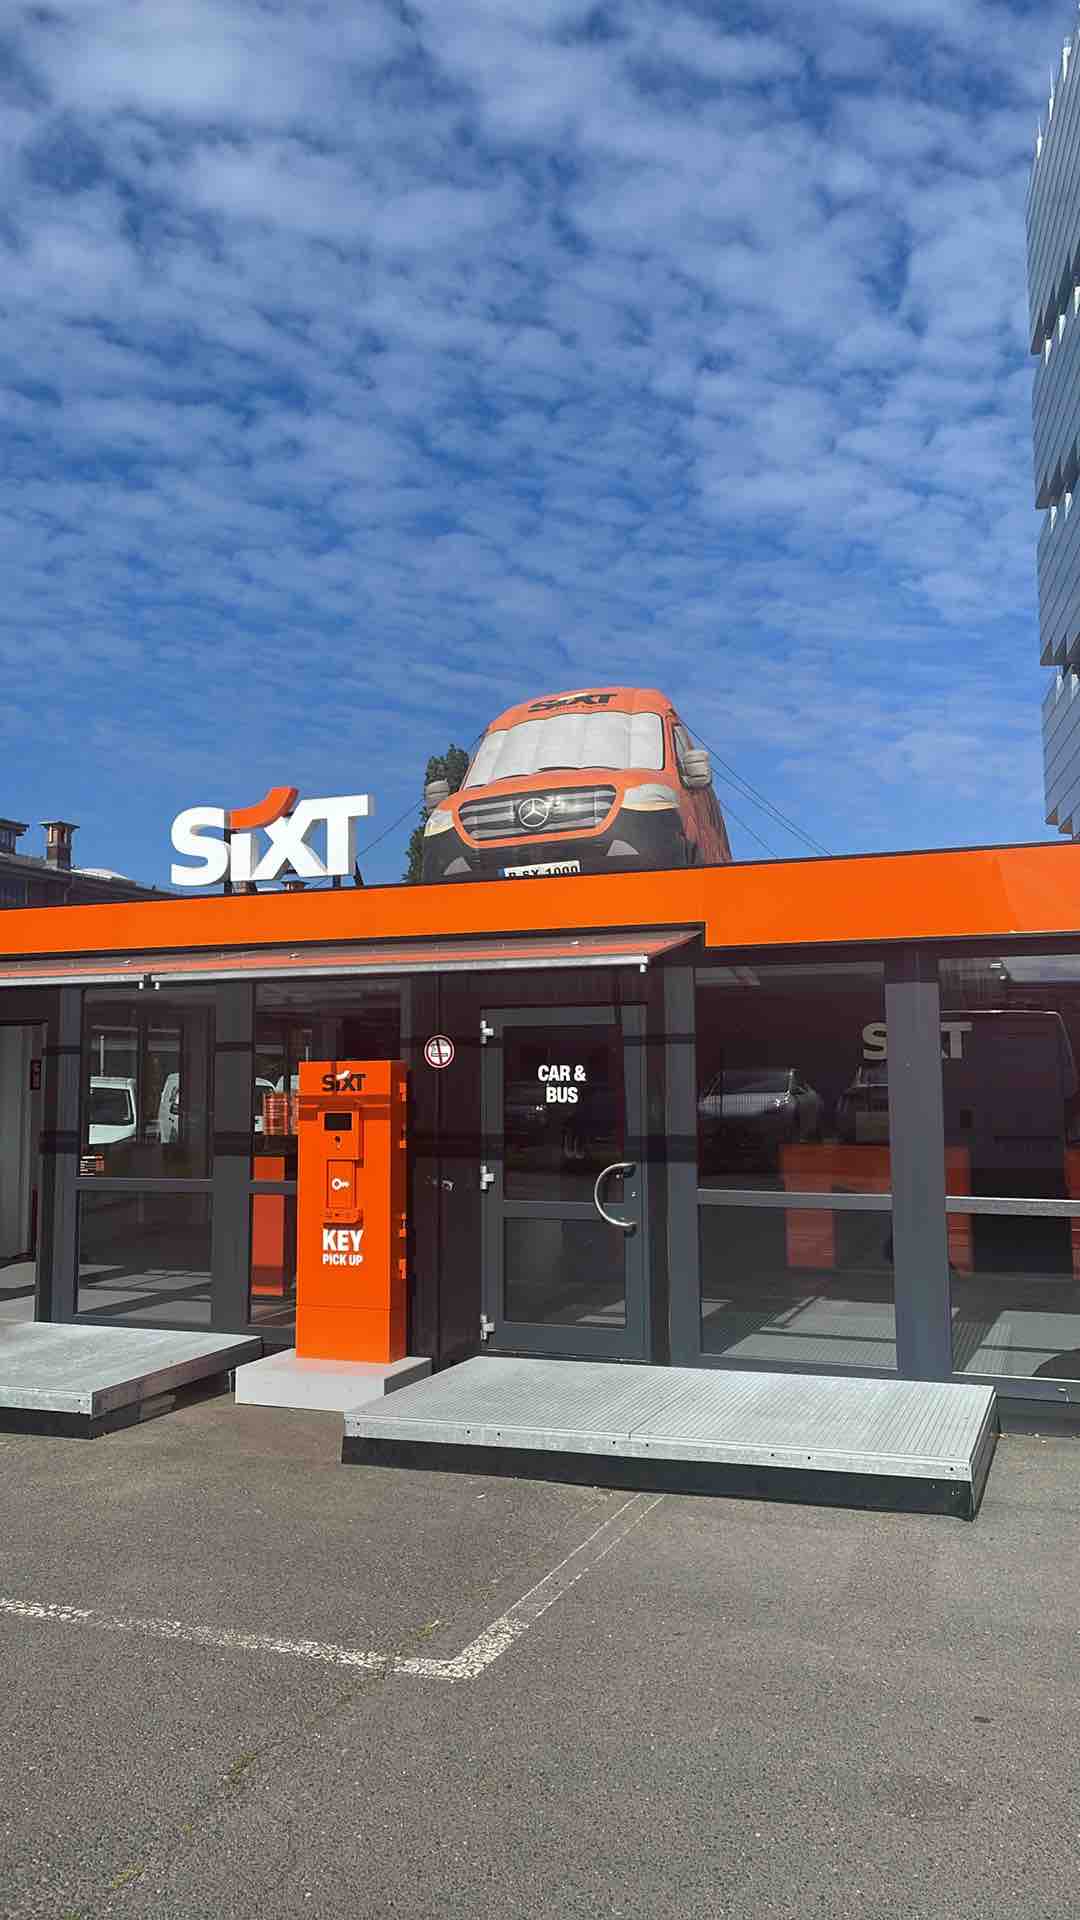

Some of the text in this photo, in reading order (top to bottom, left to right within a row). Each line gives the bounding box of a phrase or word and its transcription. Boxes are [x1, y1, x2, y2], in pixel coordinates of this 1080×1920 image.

[862, 1021, 973, 1060] ST
[537, 1064, 587, 1082] CAR &
[545, 1086, 579, 1104] BUS
[322, 1229, 364, 1252] KEY
[322, 1253, 363, 1266] PICK UP
